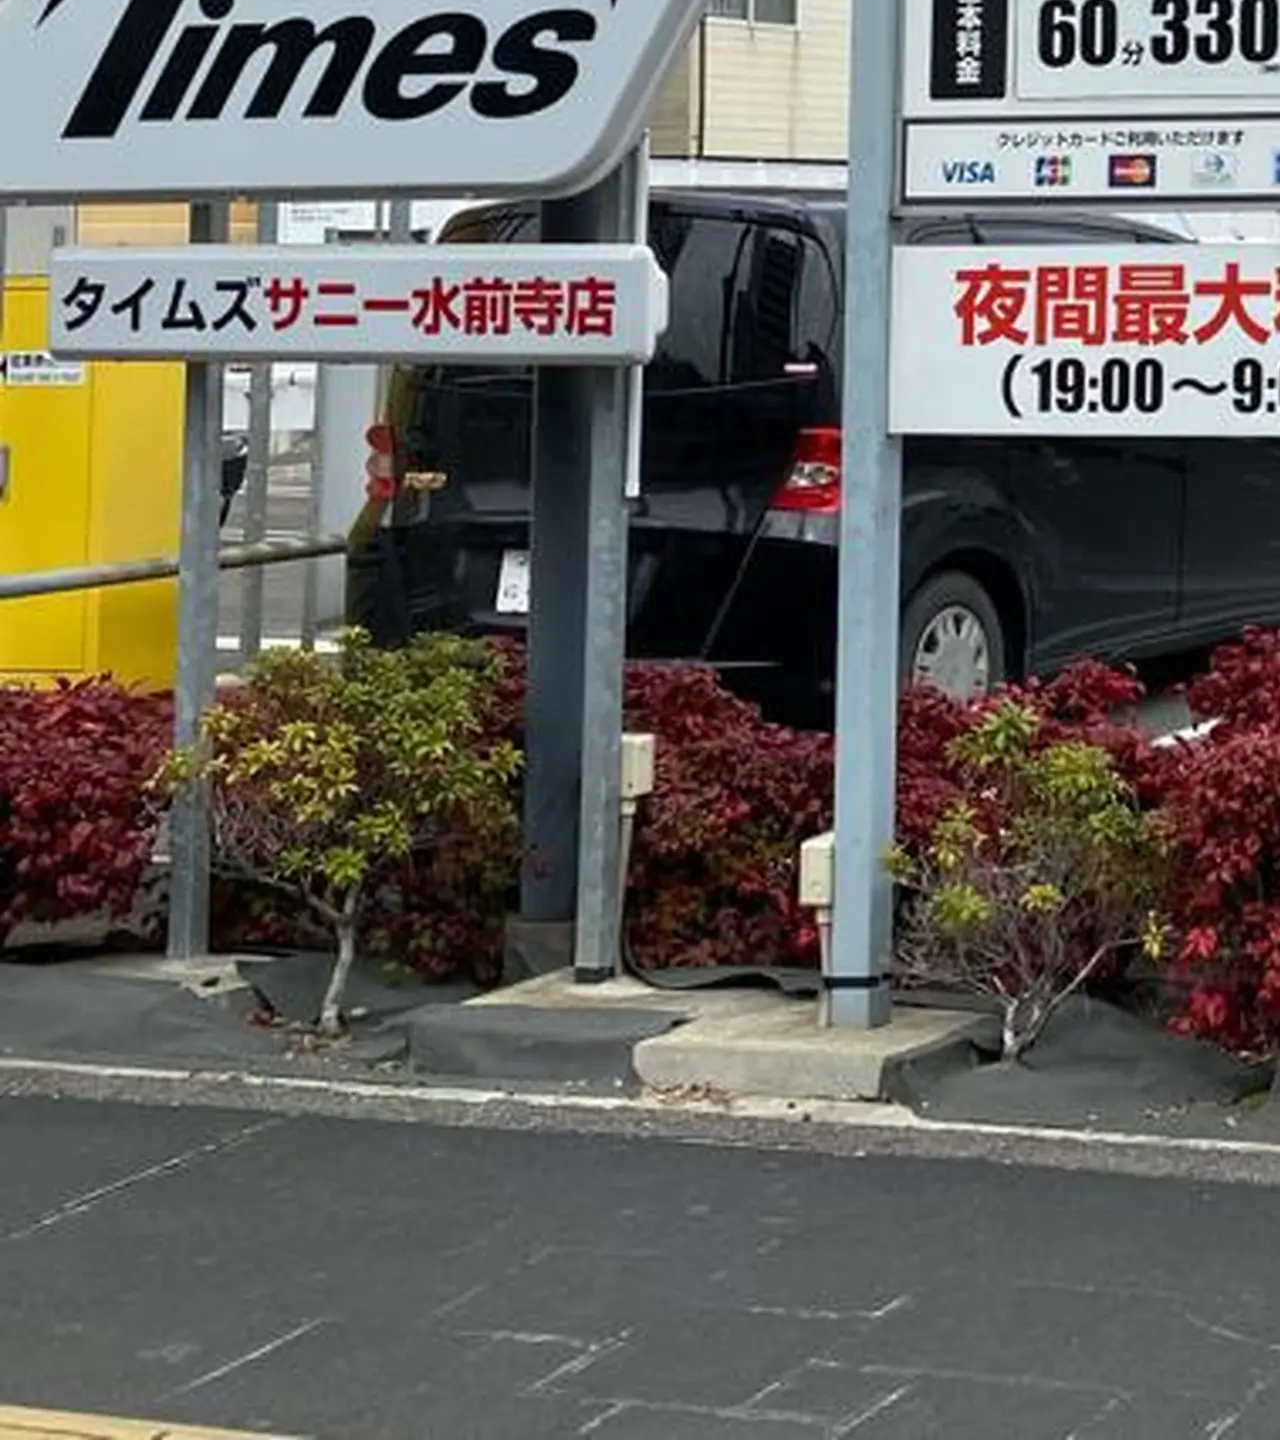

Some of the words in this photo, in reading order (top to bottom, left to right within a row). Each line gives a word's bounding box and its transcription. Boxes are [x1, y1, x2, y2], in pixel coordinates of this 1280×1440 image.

[941, 161, 996, 185] VISA
[61, 275, 617, 337] タイムズサニー水前寺店
